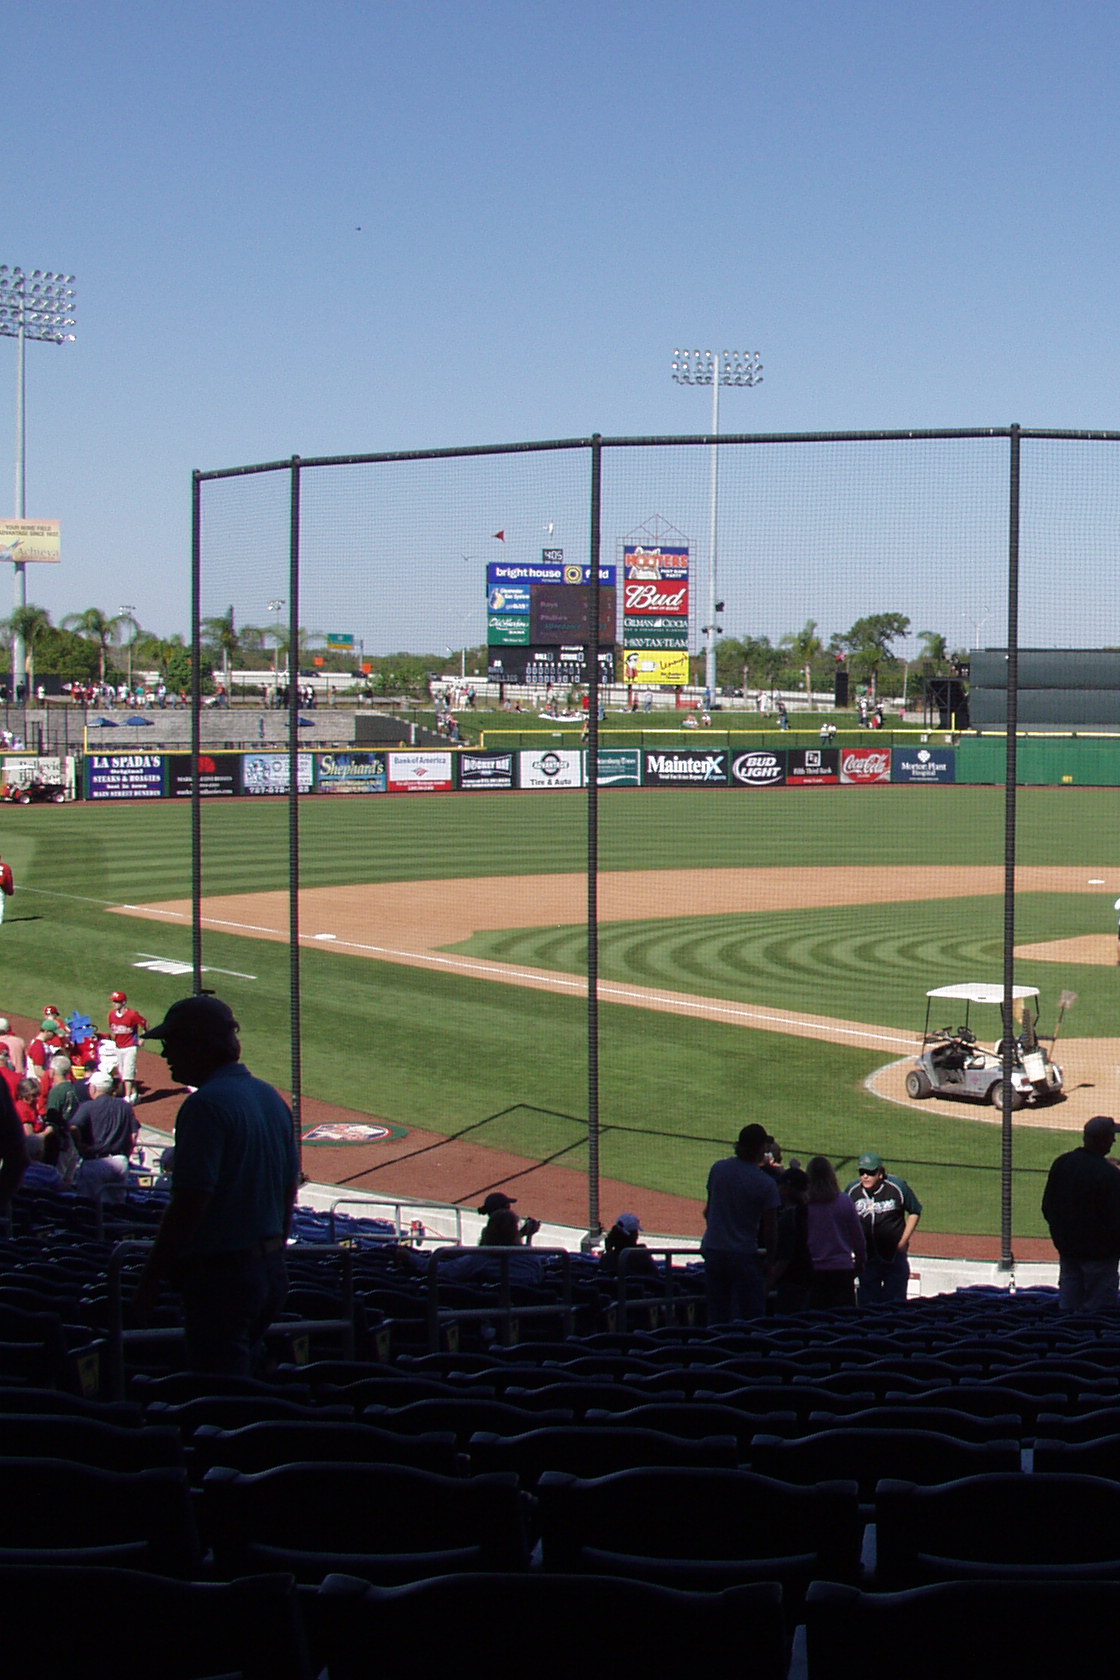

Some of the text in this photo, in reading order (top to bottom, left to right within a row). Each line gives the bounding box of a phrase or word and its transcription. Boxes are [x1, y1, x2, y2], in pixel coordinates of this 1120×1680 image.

[625, 553, 689, 568] HOOTERS
[496, 567, 609, 579] bright house fld
[626, 584, 687, 609] Bud
[93, 755, 161, 768] LA SPADA'S
[320, 754, 385, 780] Shephard's
[647, 755, 724, 780] MaintenX
[746, 757, 777, 767] BUD
[740, 767, 782, 777] LIGHT
